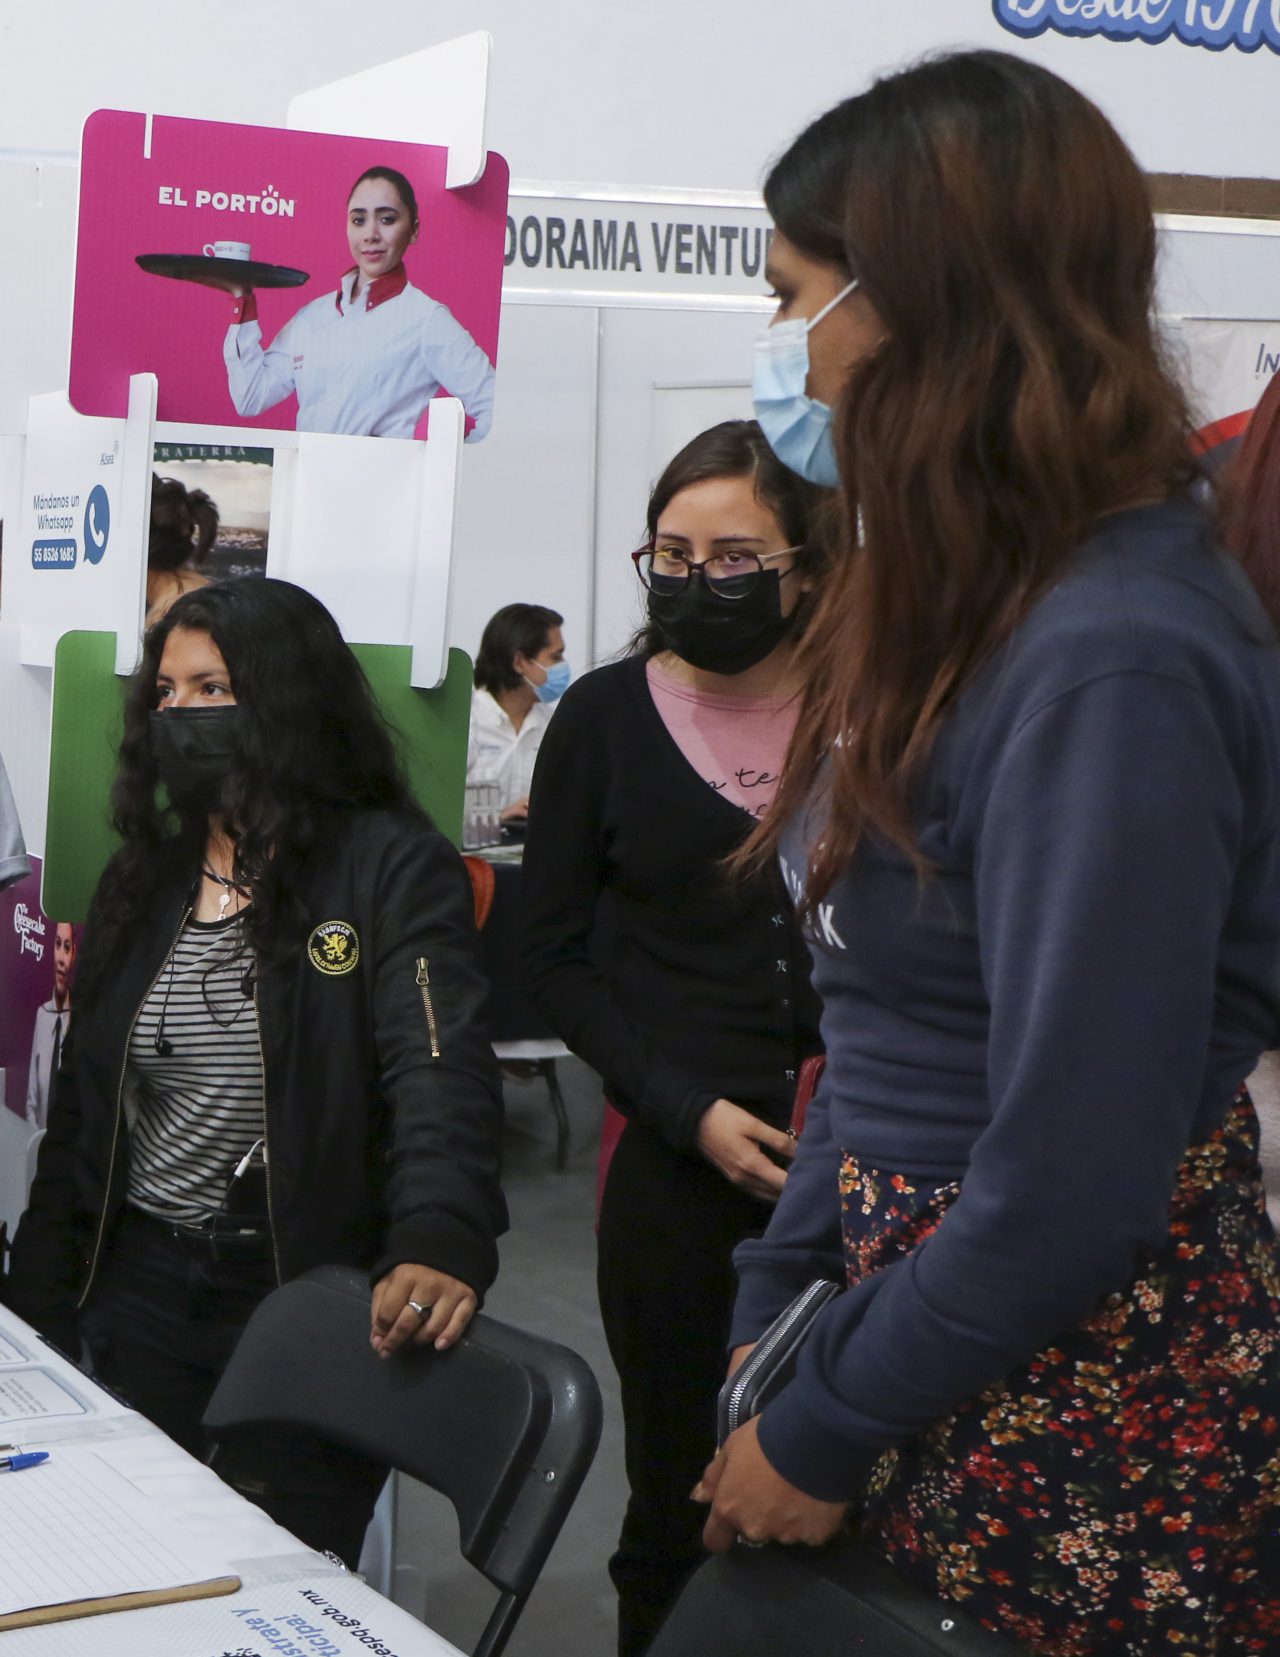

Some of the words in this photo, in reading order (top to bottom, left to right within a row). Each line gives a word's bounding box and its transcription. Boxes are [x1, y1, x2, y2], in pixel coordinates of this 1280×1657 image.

[158, 186, 187, 207] EL
[155, 446, 247, 458] RATERRA
[33, 494, 69, 510] Mándanos
[71, 494, 80, 507] un
[34, 548, 42, 562] 55
[60, 547, 75, 561] 1682
[245, 1617, 305, 1657] strate
